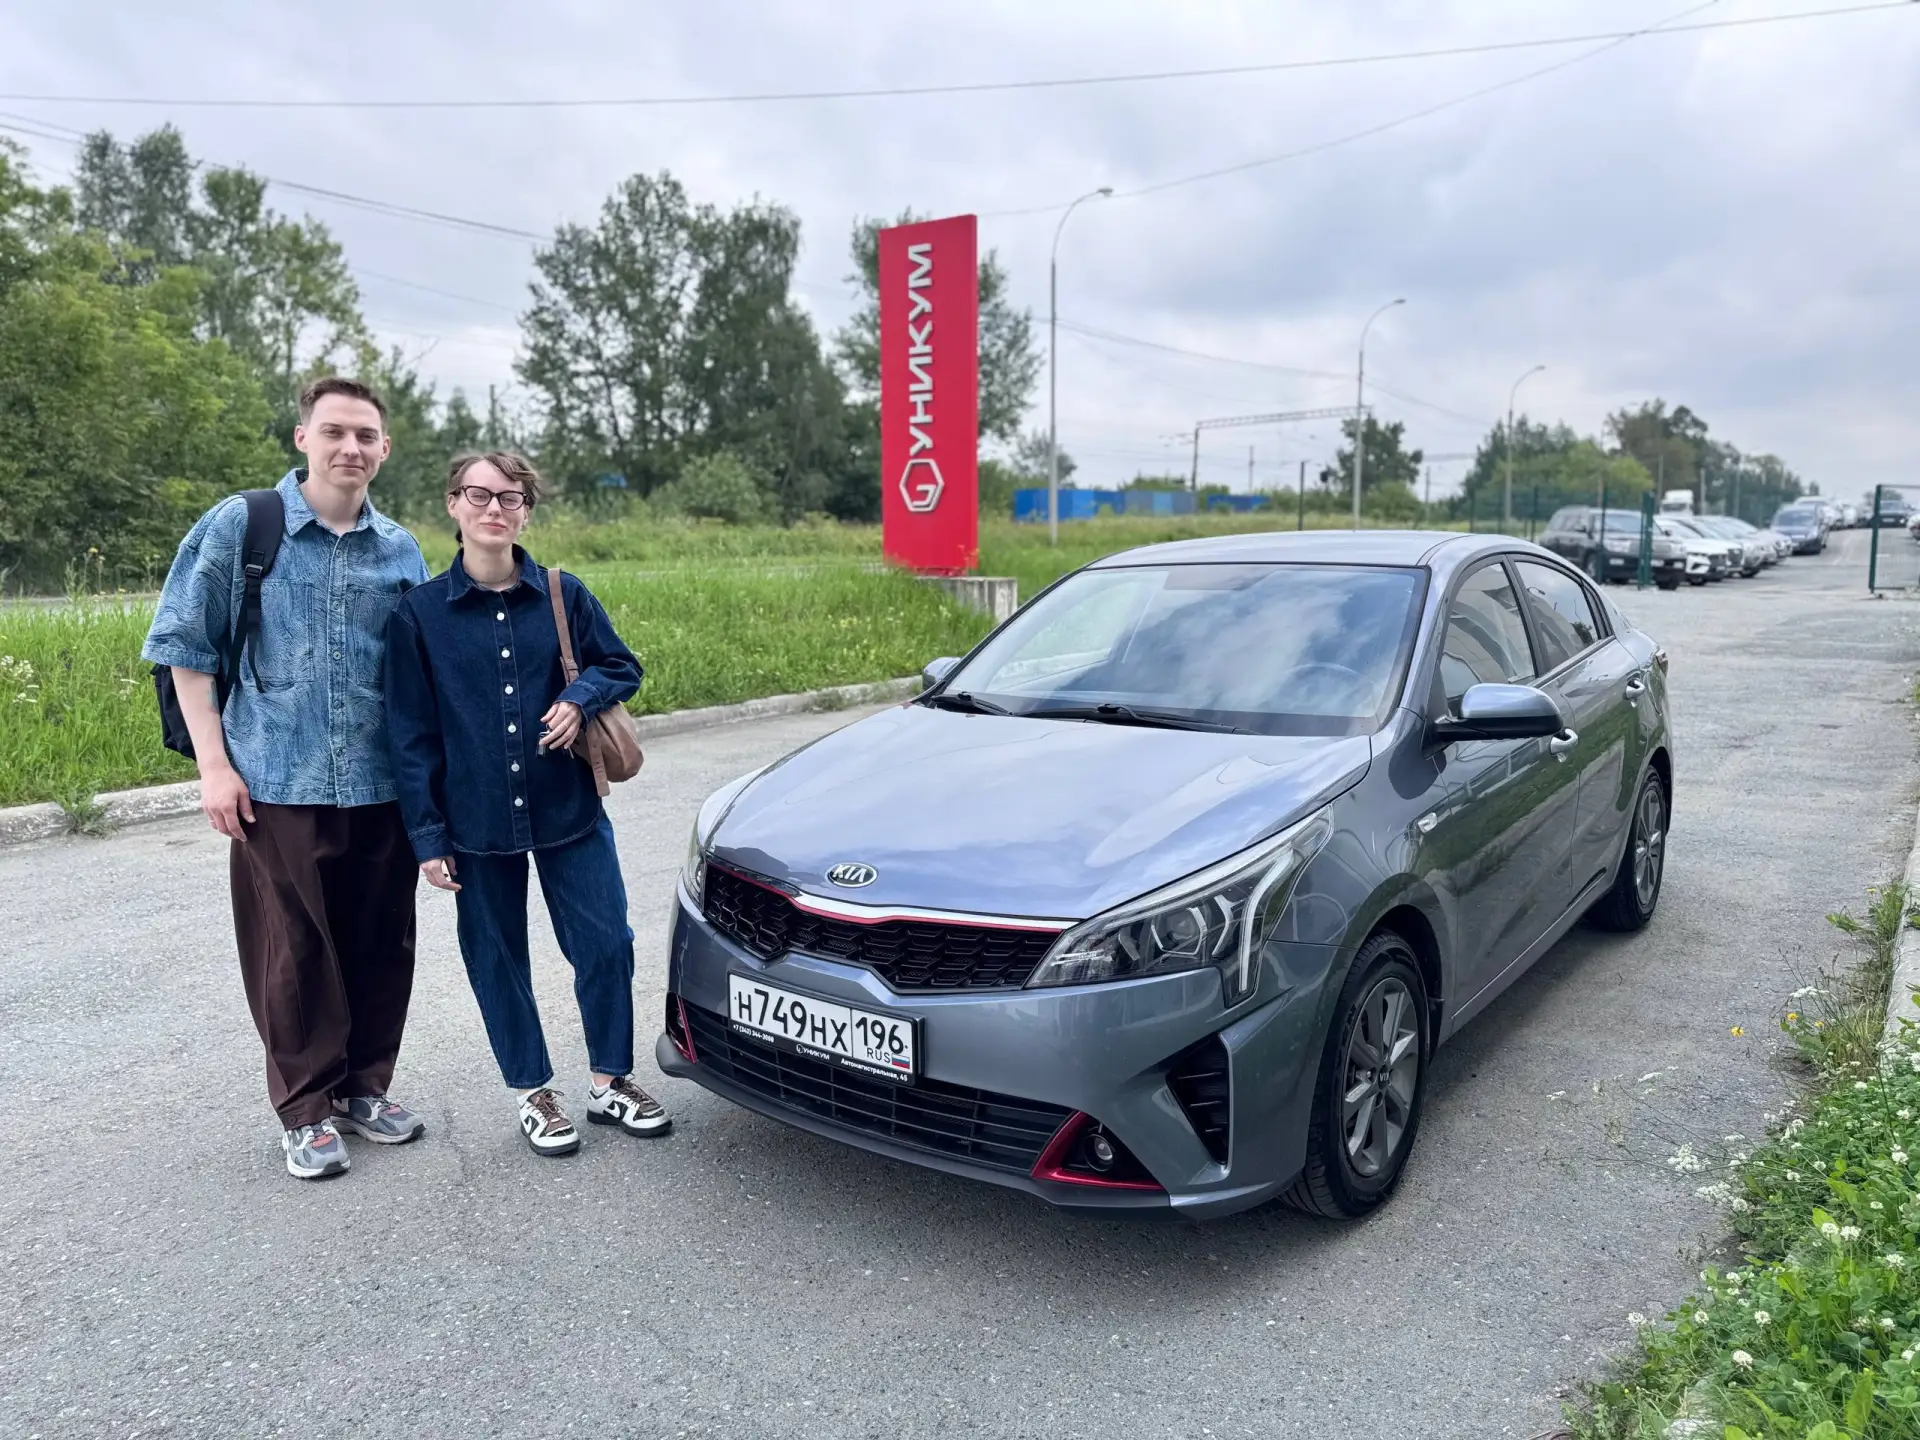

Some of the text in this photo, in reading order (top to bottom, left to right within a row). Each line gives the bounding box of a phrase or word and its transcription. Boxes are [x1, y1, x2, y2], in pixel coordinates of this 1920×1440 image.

[908, 243, 933, 456] УНИКУМ
[831, 863, 868, 883] KIA
[855, 1016, 904, 1054] 196
[803, 1047, 830, 1060] УНИКУМ
[867, 1047, 891, 1063] RUS
